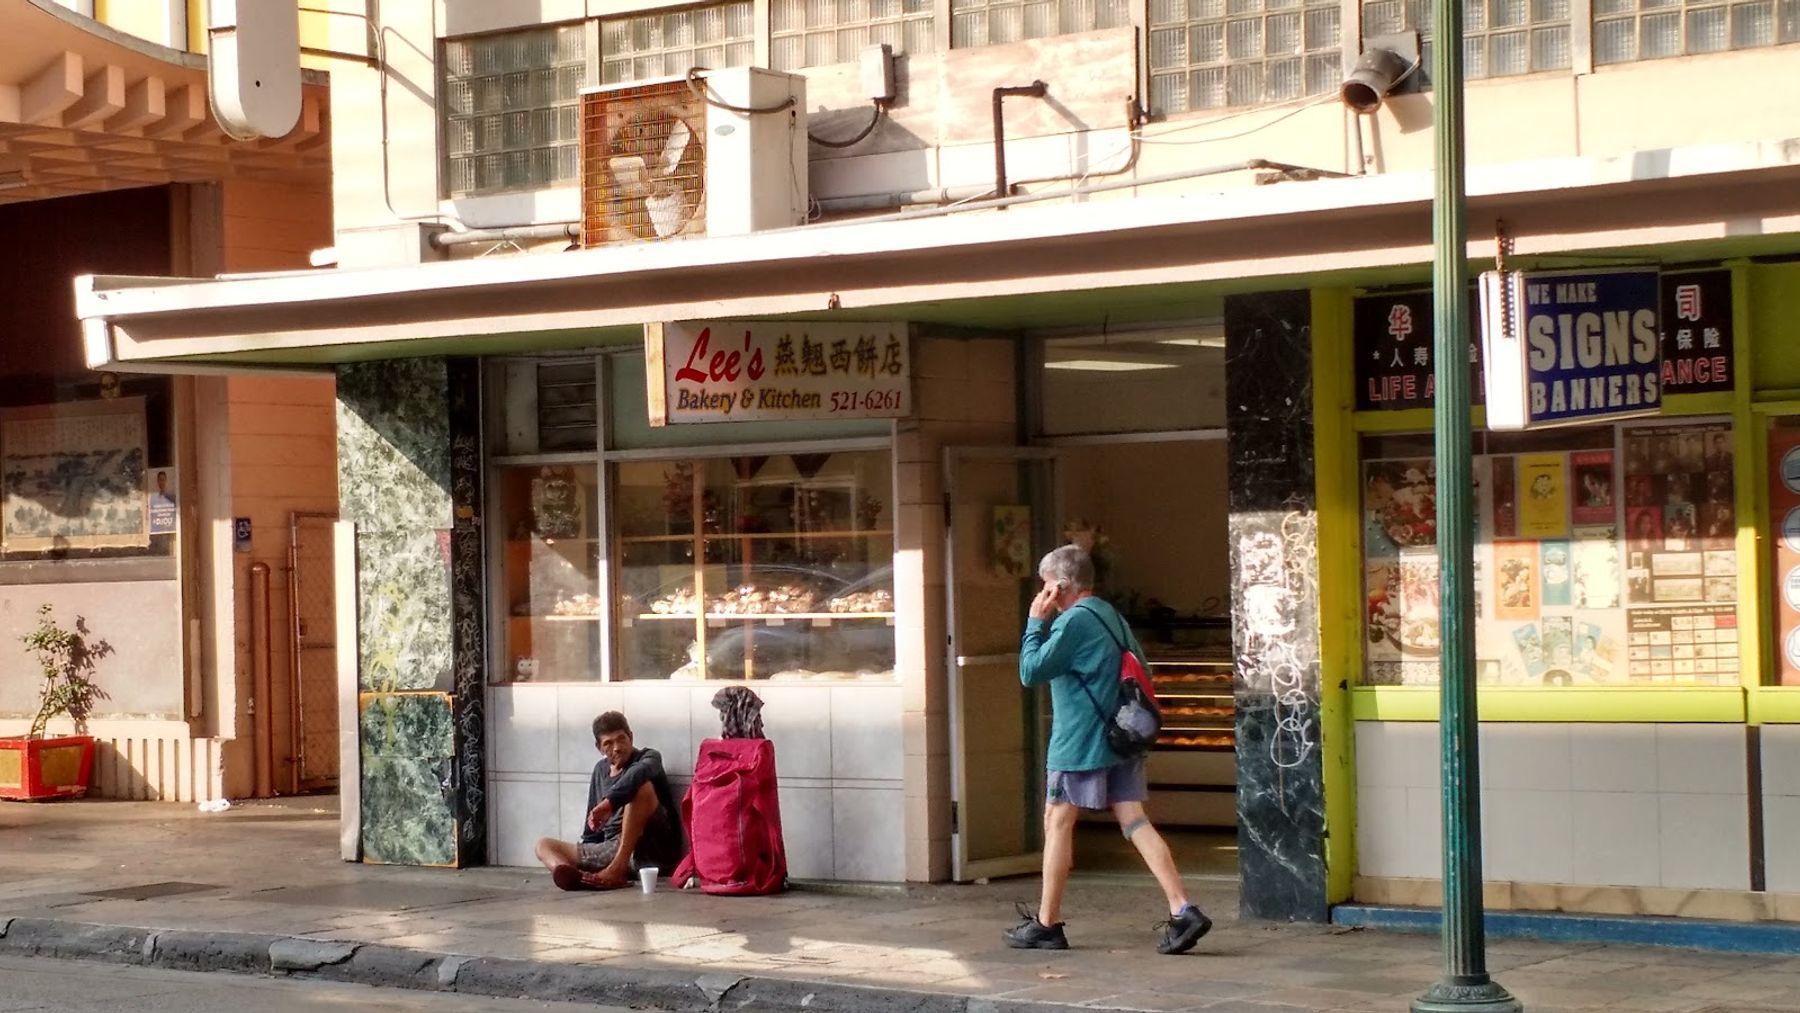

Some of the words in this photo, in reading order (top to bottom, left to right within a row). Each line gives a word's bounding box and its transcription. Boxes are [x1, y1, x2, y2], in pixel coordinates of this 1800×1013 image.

[1388, 304, 1412, 341] 华
[1675, 284, 1701, 321] 司
[1528, 284, 1550, 305] WE
[1556, 282, 1597, 303] MAKE
[675, 327, 766, 383] Lee's
[1528, 309, 1657, 371] SIGNS
[676, 388, 737, 414] Bakery
[740, 389, 754, 409] &
[757, 388, 821, 410] Kitchen
[830, 389, 902, 412] 521-6261
[1369, 375, 1416, 401] LIFE
[1531, 374, 1658, 414] BANNERS
